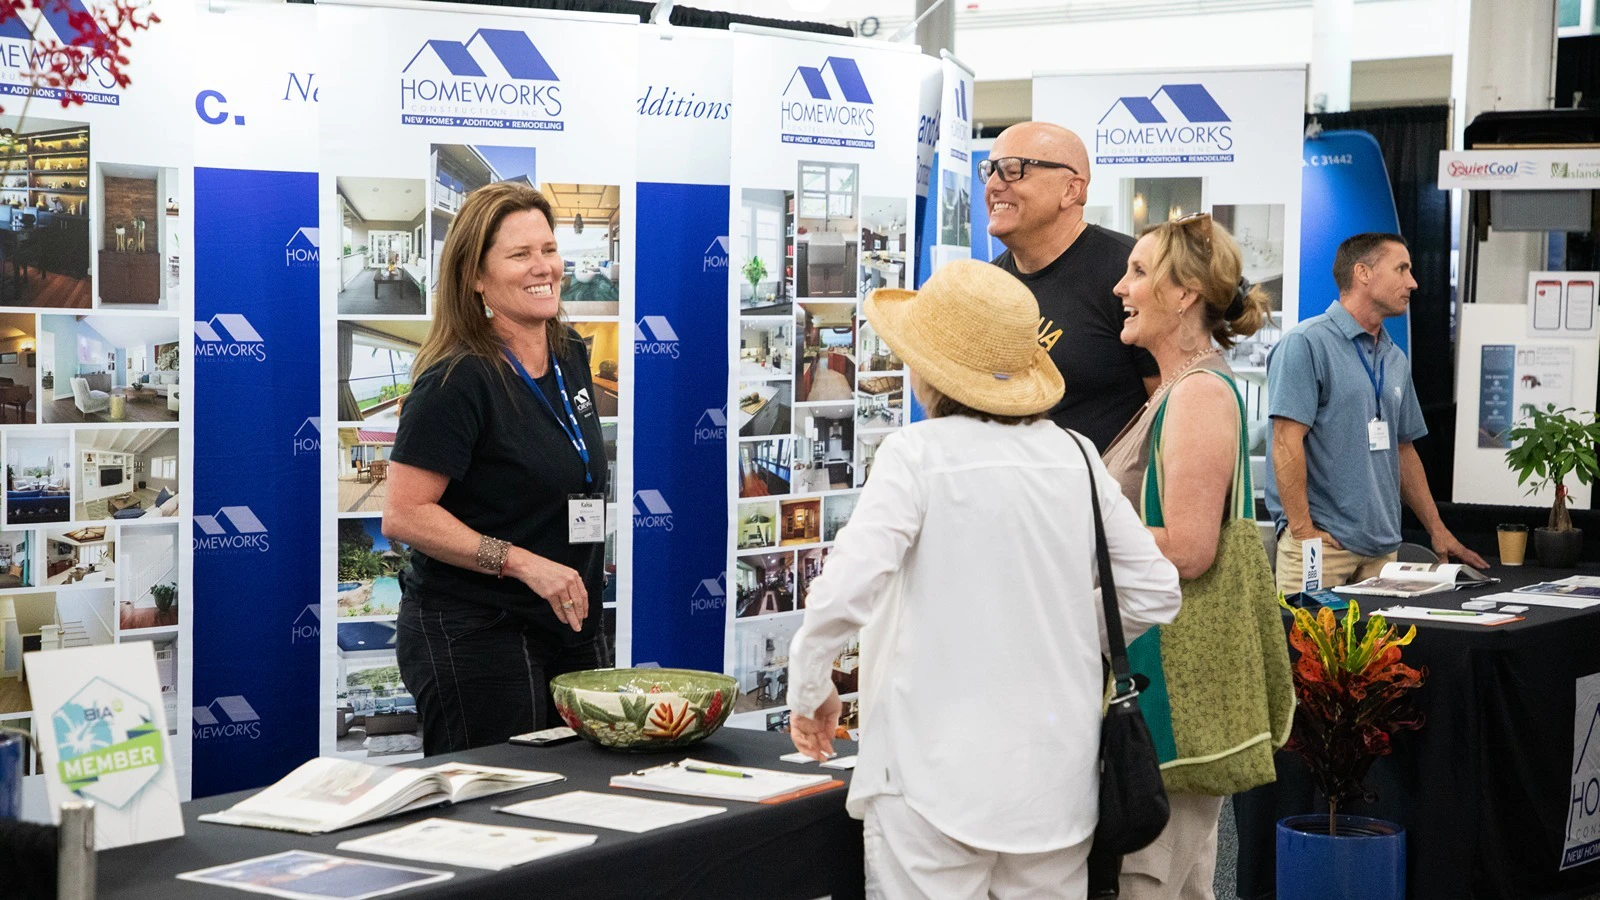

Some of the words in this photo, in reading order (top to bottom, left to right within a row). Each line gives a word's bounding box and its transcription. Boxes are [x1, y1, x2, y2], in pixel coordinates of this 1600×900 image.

[0, 42, 117, 89] EWORKS
[65, 91, 117, 104] REODELING
[401, 78, 562, 117] HOMEWORKS
[404, 115, 424, 124] NEW
[425, 116, 454, 126] HOMES
[462, 118, 504, 128] ADDITIONS
[511, 121, 562, 131] REMODELING
[781, 101, 875, 136] HOMEWORKS
[817, 137, 841, 145] ADDITIONS
[845, 139, 874, 148] REMODELING
[1095, 125, 1233, 153] HOMEWORKS
[194, 343, 266, 362] MEWORKS
[1307, 569, 1318, 580] BBB
[64, 745, 157, 779] MEMBER
